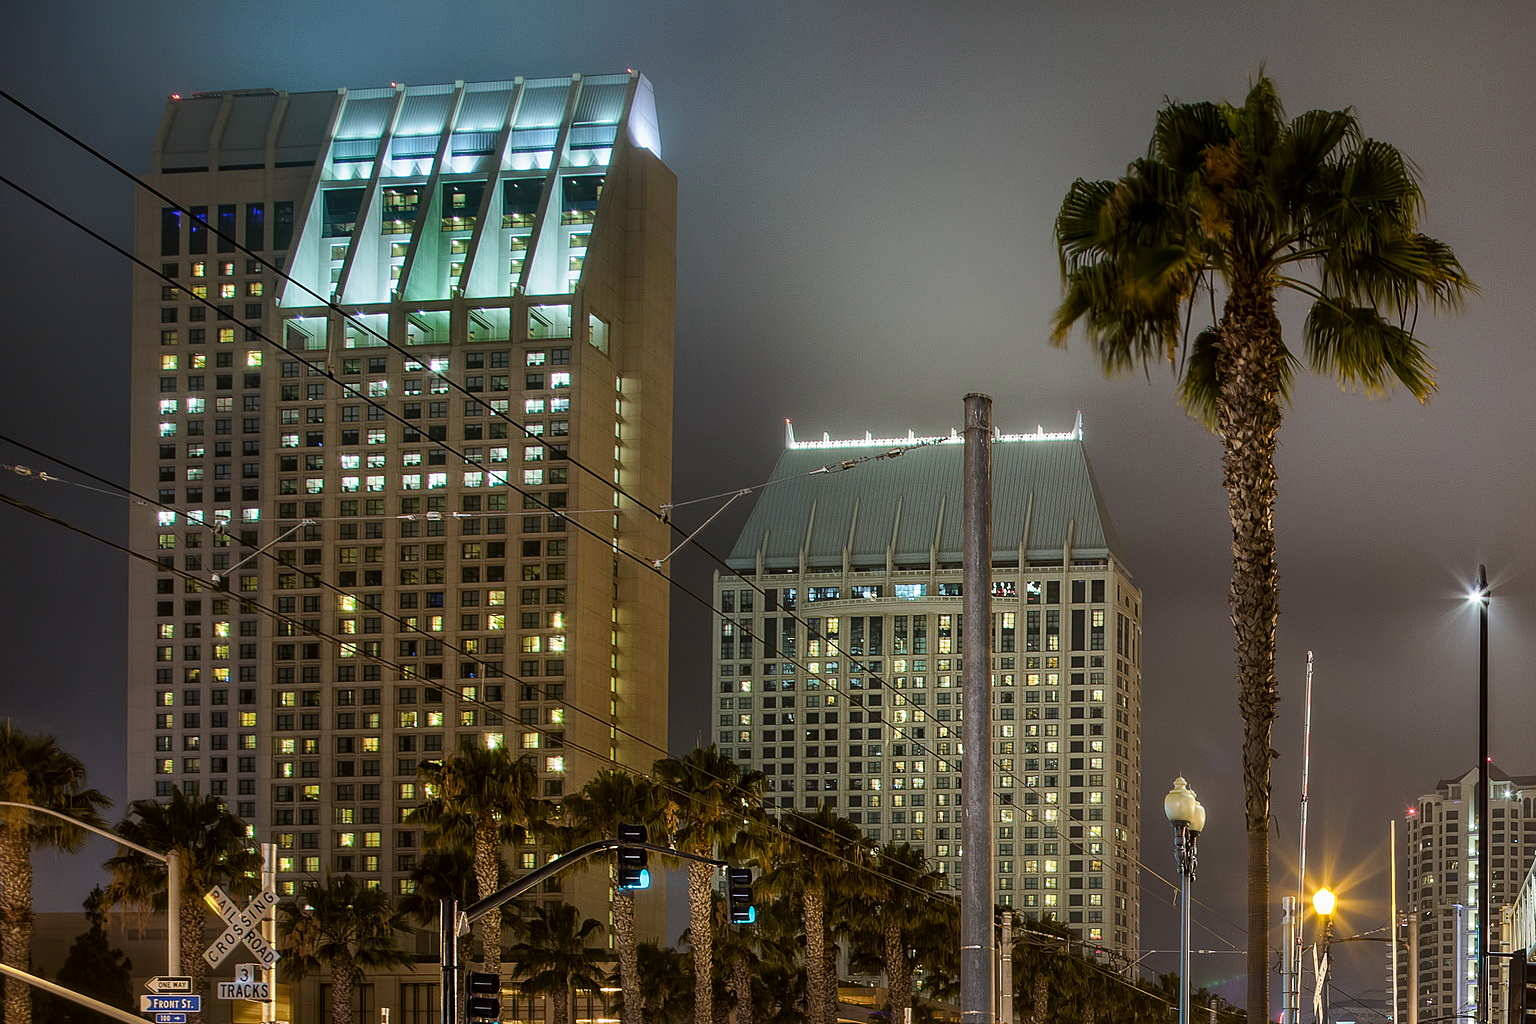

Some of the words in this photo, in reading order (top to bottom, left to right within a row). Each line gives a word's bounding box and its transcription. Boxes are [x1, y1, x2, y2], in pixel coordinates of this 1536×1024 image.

[207, 891, 274, 963] CROSSING
[240, 969, 248, 982] 3
[220, 984, 268, 998] TRACKS
